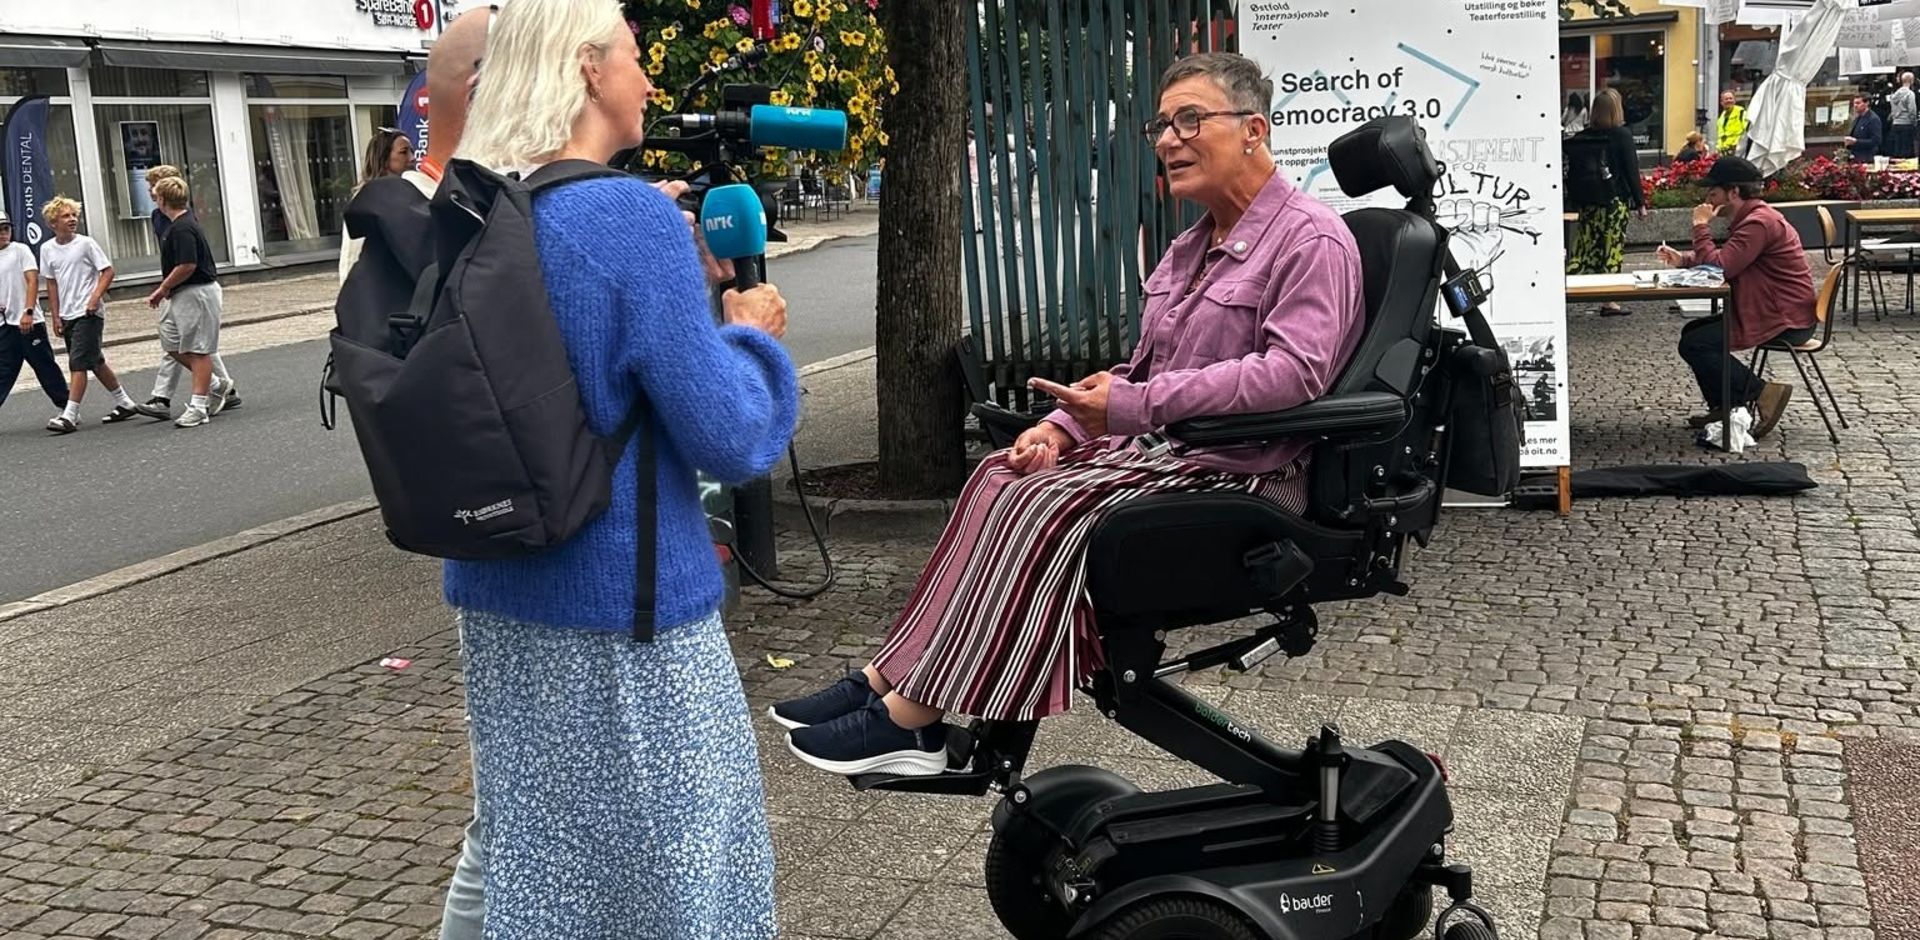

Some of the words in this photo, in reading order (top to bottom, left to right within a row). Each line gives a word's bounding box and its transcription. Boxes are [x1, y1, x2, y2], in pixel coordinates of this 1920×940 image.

[1249, 2, 1290, 12] Østfold
[1464, 2, 1506, 11] Utstilling
[1507, 2, 1519, 11] og
[1520, 0, 1546, 8] bøker
[1255, 10, 1330, 21] Internasjonale
[1470, 10, 1547, 21] Teaterforestilling
[1252, 22, 1284, 31] Teater
[1281, 70, 1370, 94] Search
[1377, 66, 1404, 89] of
[1271, 104, 1396, 126] emocracy
[1402, 98, 1441, 119] 3.0
[415, 118, 429, 172] Bank
[1437, 136, 1545, 163] ASJEMENT
[19, 132, 33, 184] DENTAL
[1272, 146, 1328, 158] unstprosjekt
[1452, 162, 1487, 171] FOR
[1291, 893, 1335, 911] balder
